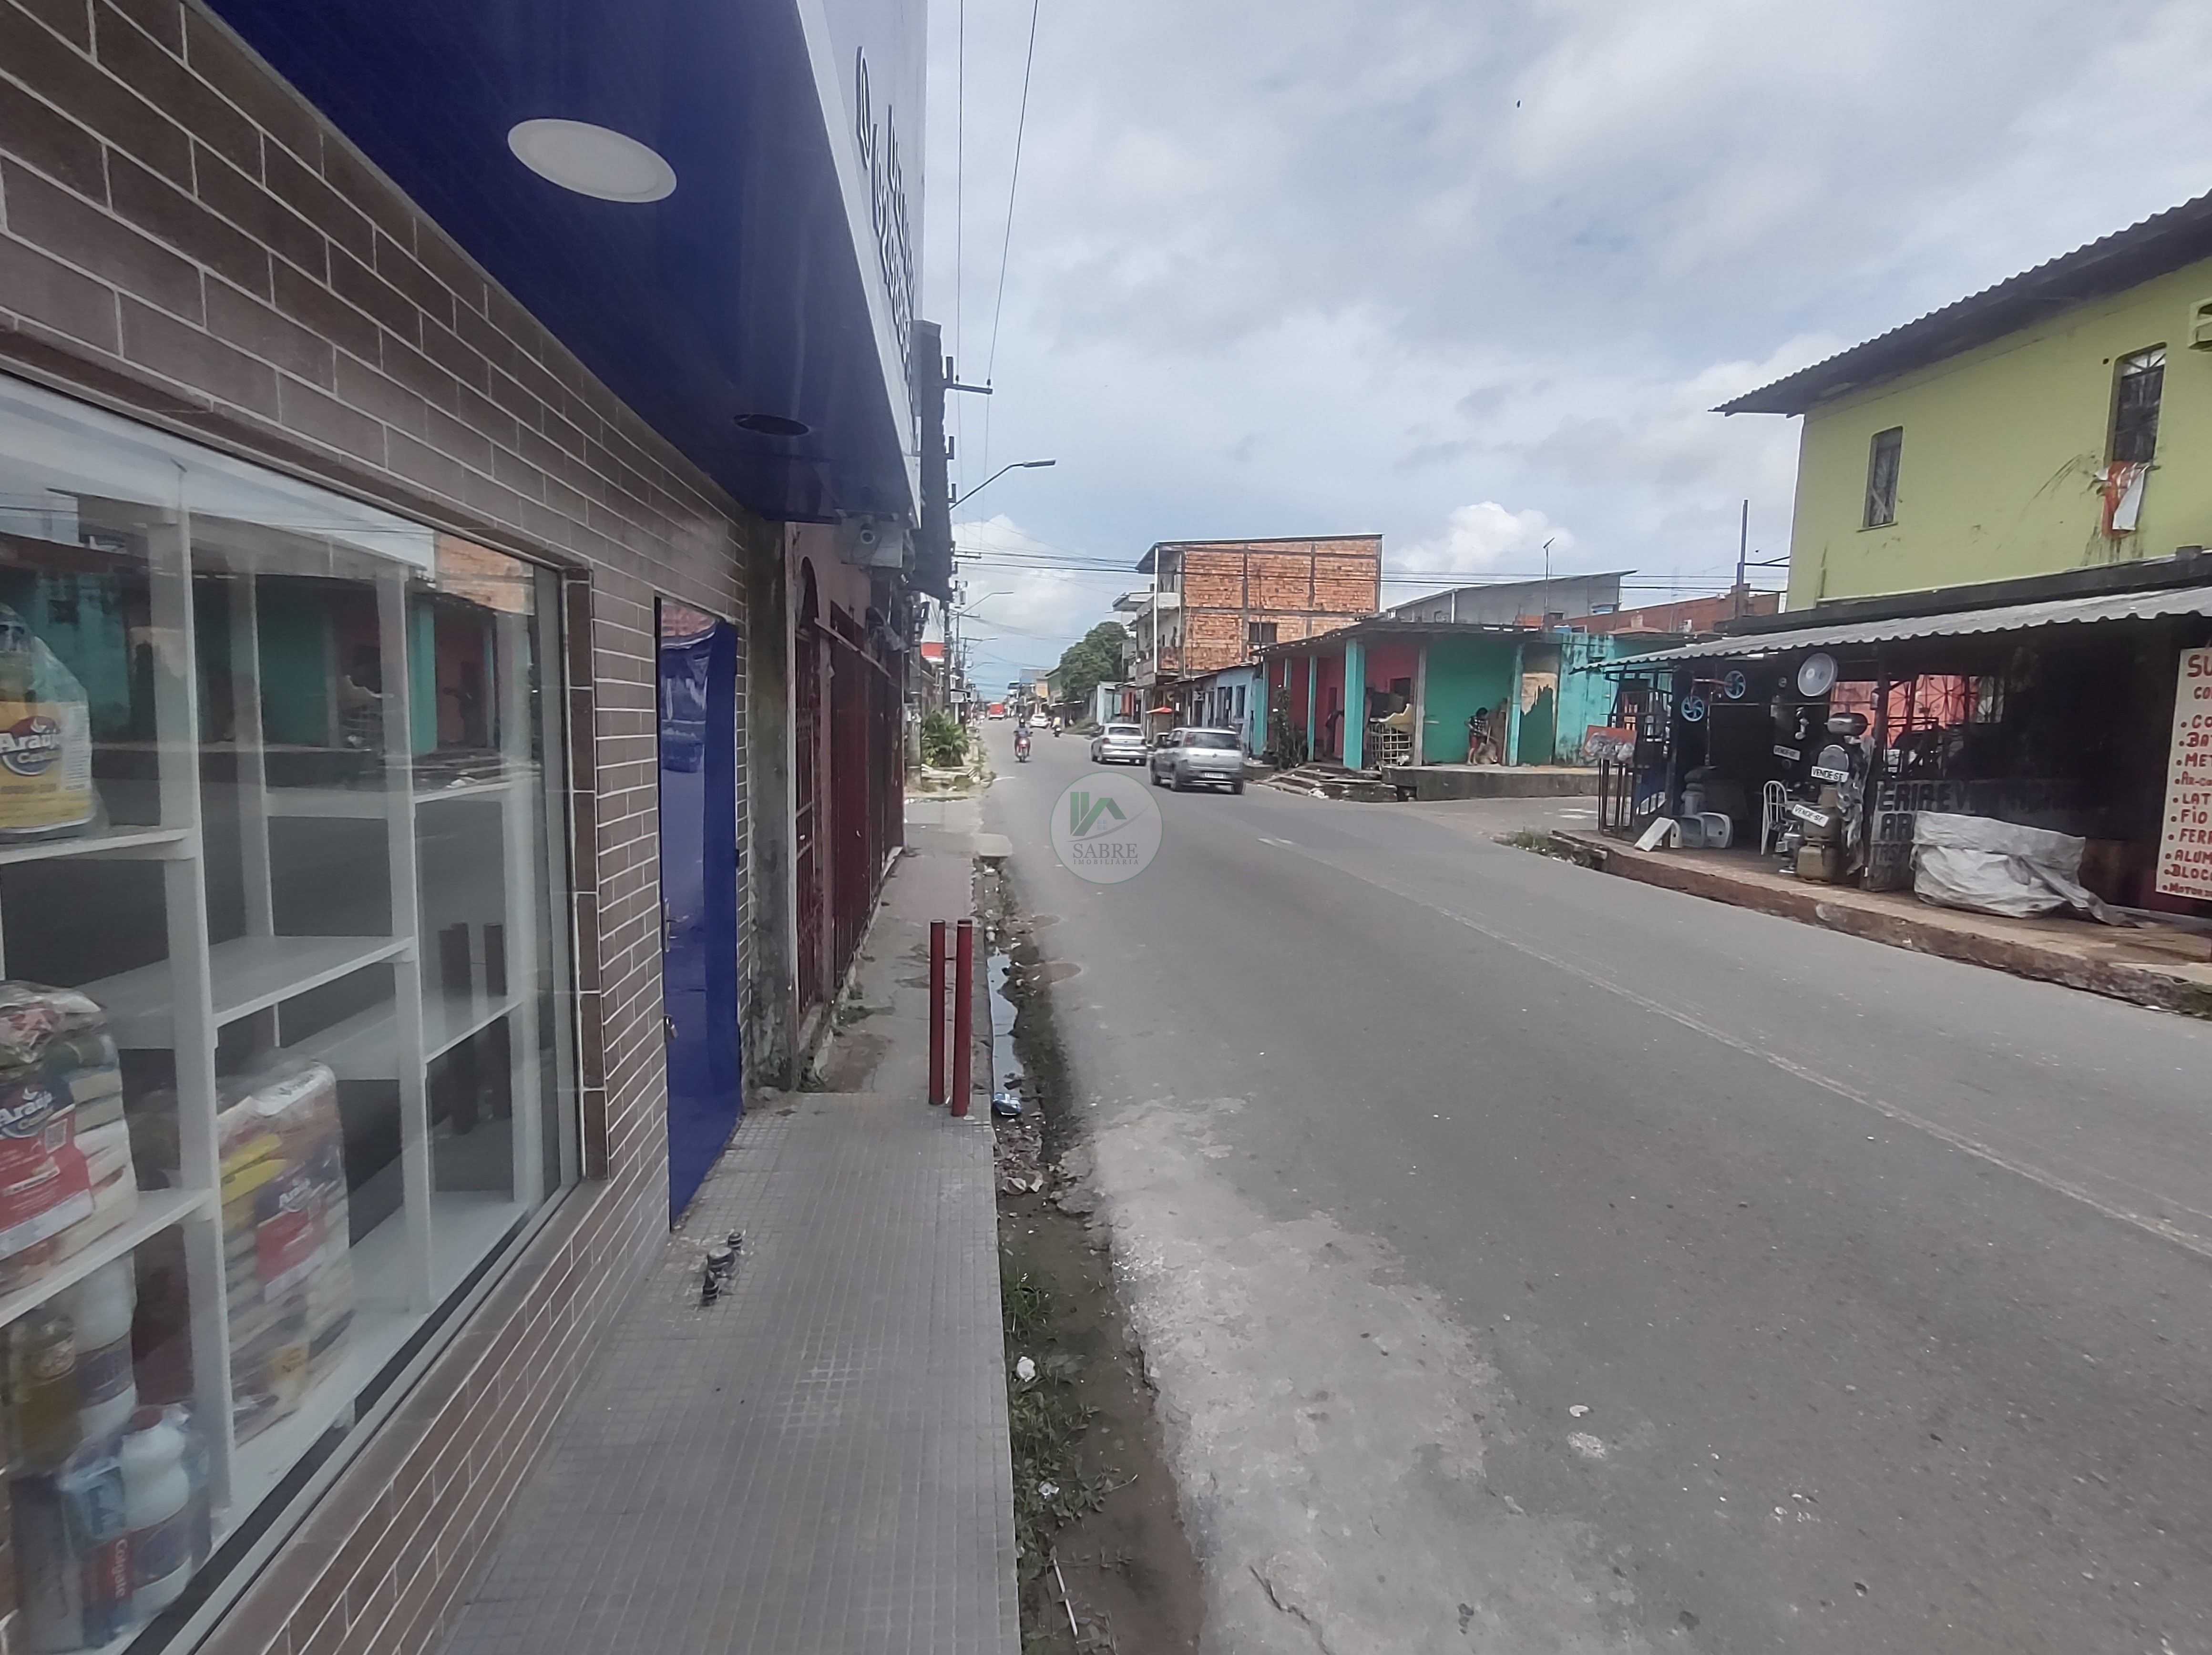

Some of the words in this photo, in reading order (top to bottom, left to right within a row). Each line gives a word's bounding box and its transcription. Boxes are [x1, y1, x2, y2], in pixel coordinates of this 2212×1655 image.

[1813, 767, 1843, 780] VENDE-SE
[1794, 806, 1825, 823] VENDE-SE
[112, 1539, 128, 1599] Colgate
